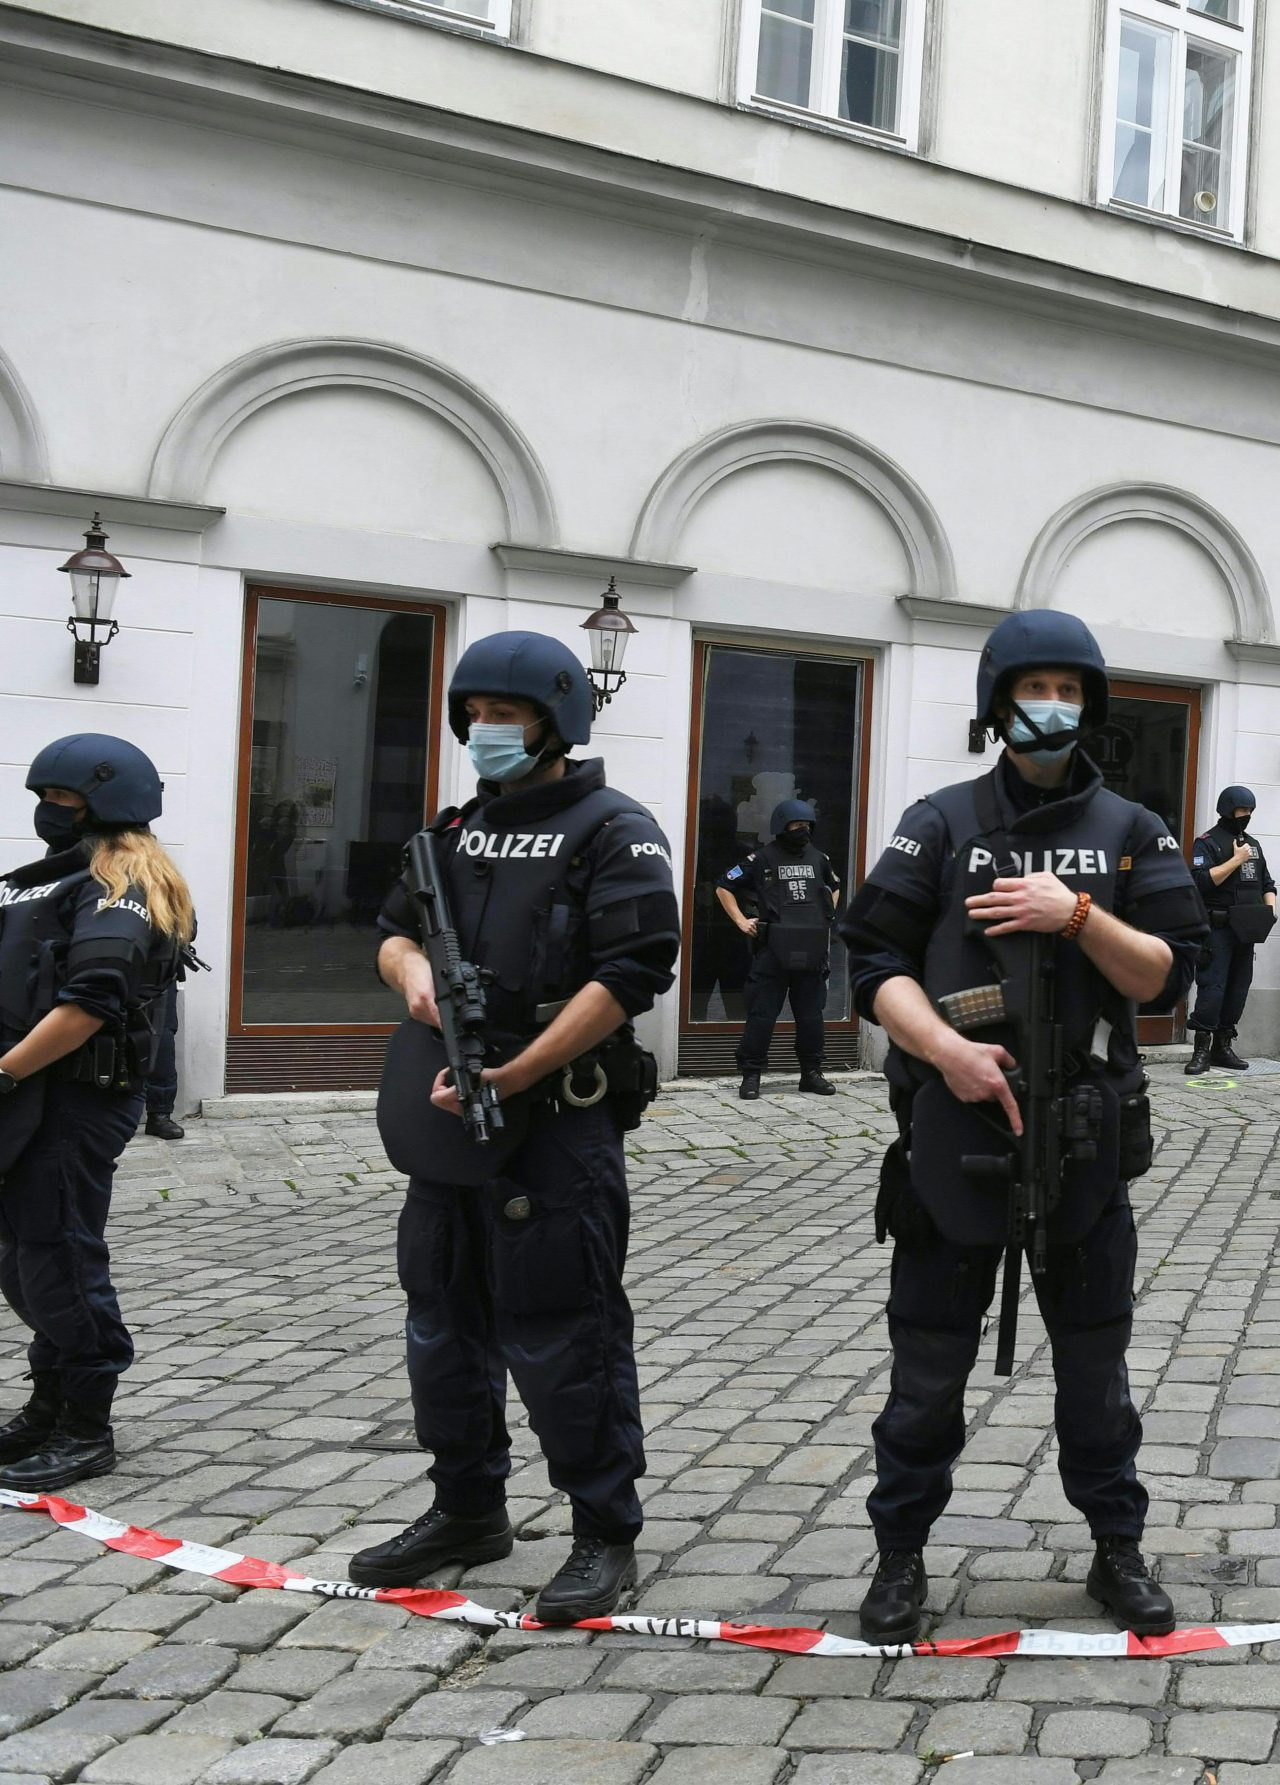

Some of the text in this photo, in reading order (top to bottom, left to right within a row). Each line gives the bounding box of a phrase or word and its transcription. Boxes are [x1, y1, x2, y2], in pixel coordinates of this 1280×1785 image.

[456, 828, 564, 858] POLIZEI
[888, 835, 921, 857] IZEI
[1157, 836, 1180, 851] PO
[788, 880, 807, 891] BE
[792, 889, 806, 900] 53
